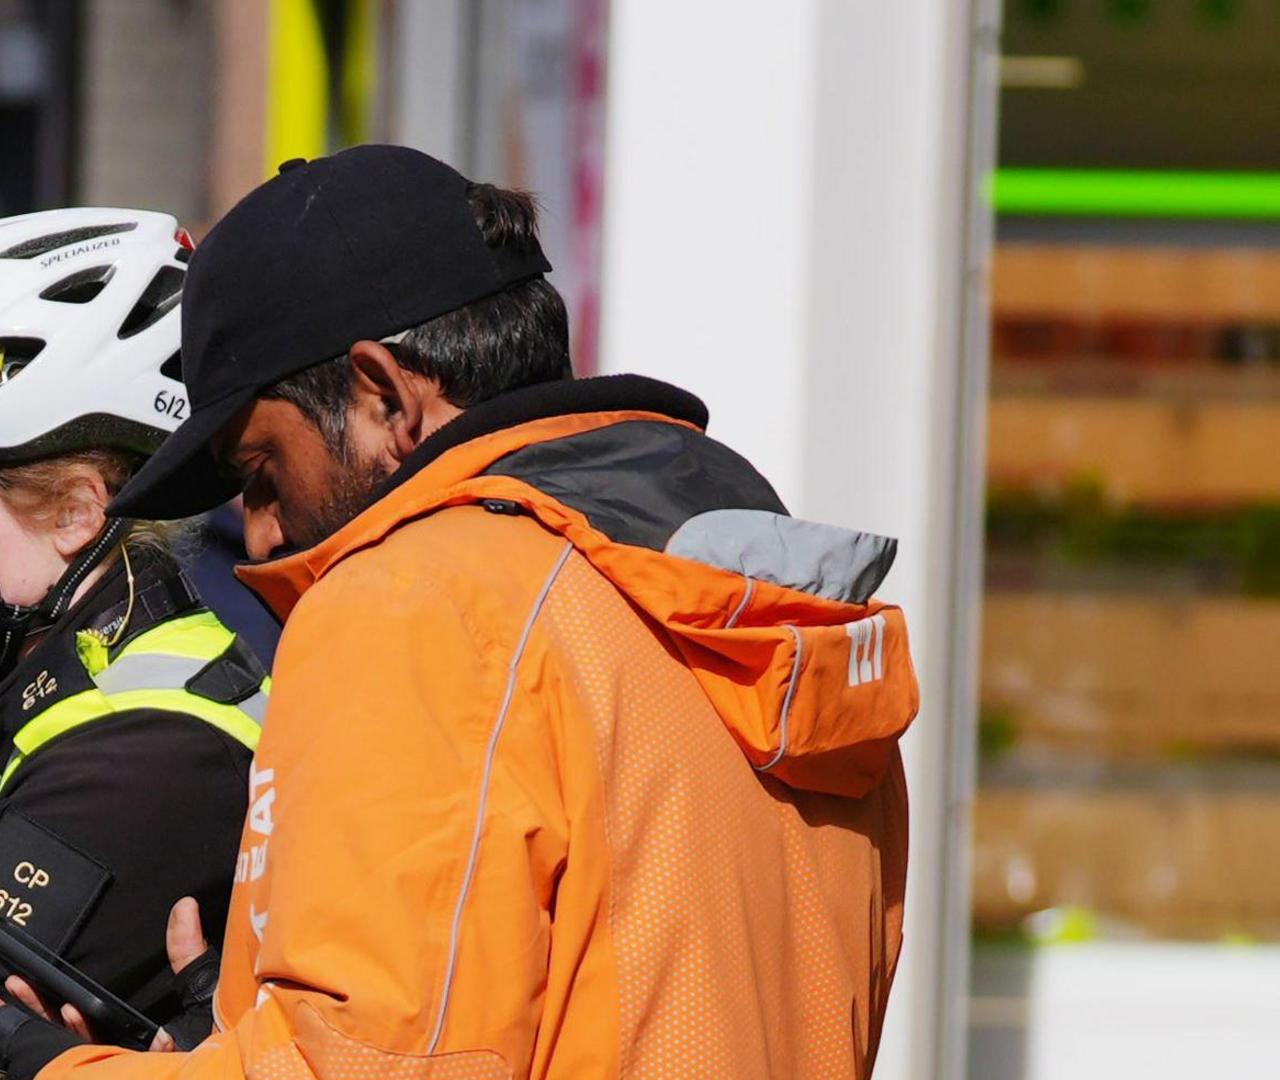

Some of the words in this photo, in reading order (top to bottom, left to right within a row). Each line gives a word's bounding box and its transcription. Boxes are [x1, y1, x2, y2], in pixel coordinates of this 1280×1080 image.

[39, 238, 121, 270] SPECIALIZED
[153, 389, 186, 421] 612
[22, 670, 49, 699] CP
[22, 677, 59, 711] 612
[248, 757, 278, 884] EAT
[12, 860, 51, 889] CP
